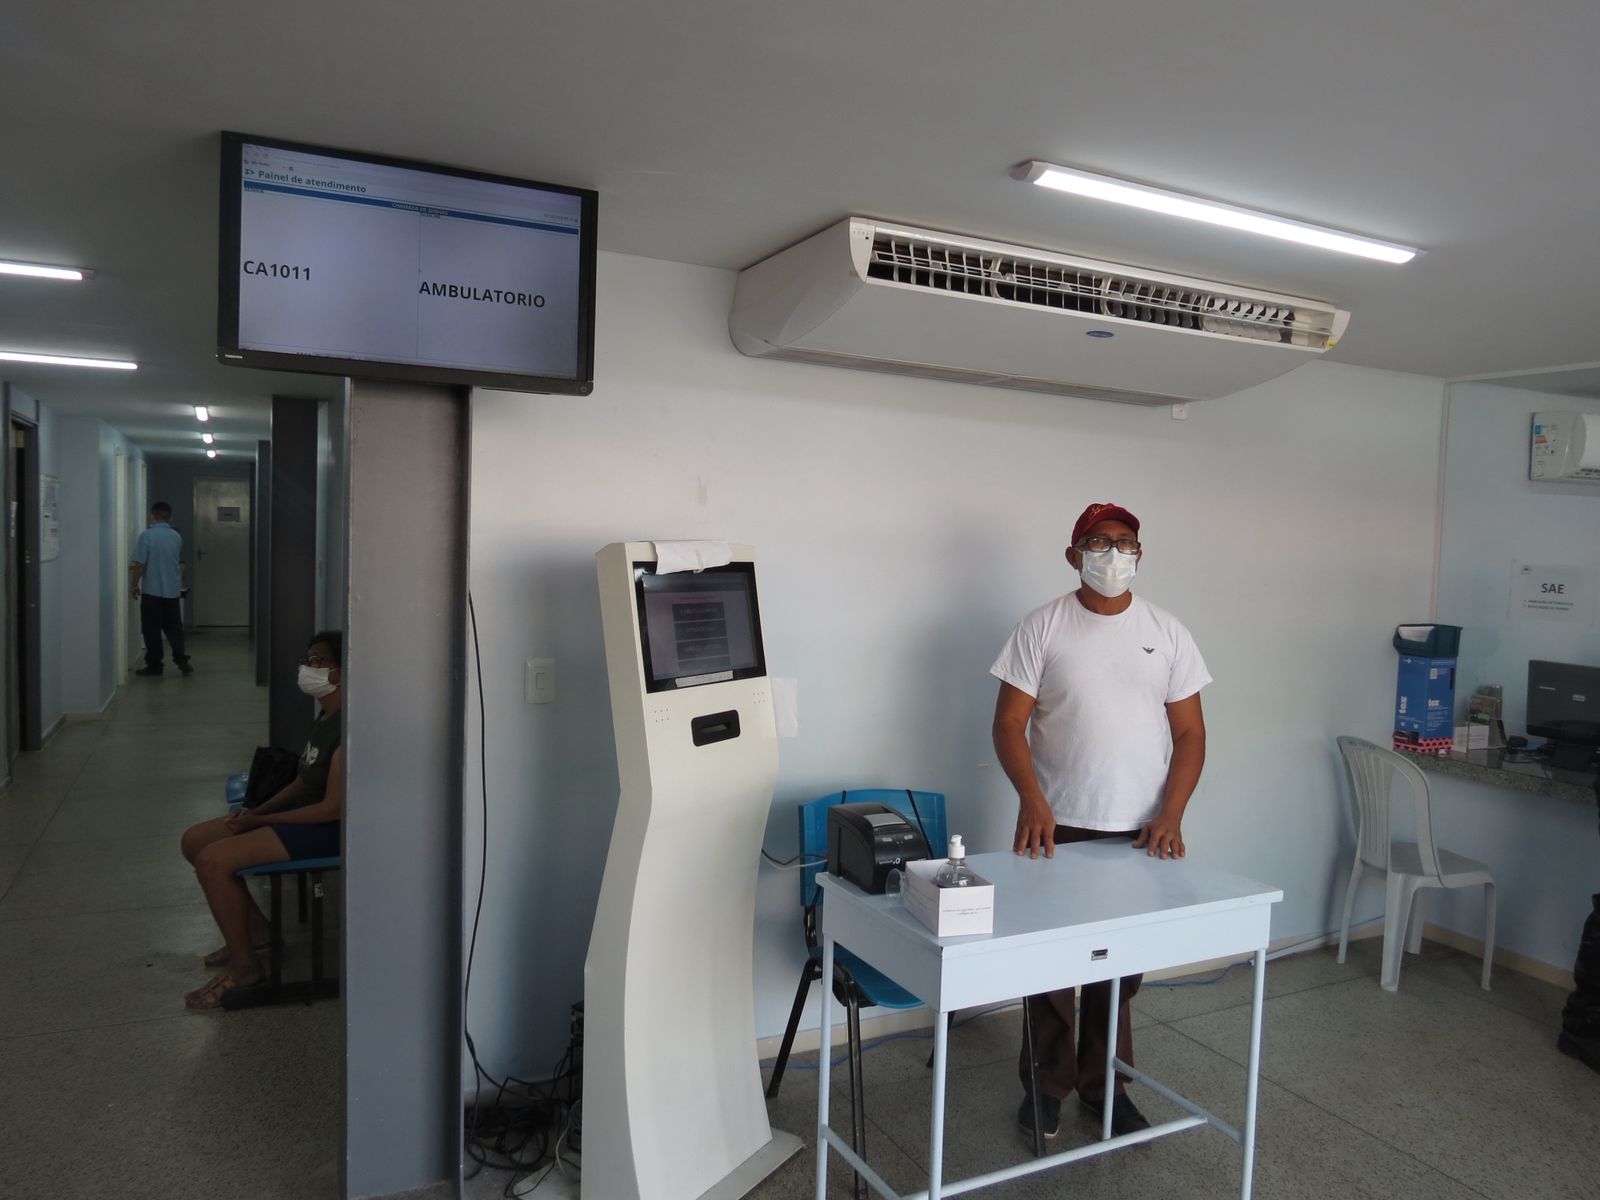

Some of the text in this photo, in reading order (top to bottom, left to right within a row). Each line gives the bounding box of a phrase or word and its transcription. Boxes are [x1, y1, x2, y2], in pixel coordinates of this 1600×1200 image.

[258, 169, 367, 193] Painel de atendimento
[243, 260, 310, 281] CA1011
[419, 281, 546, 308] AMBULATORIO
[1541, 583, 1565, 594] SAE
